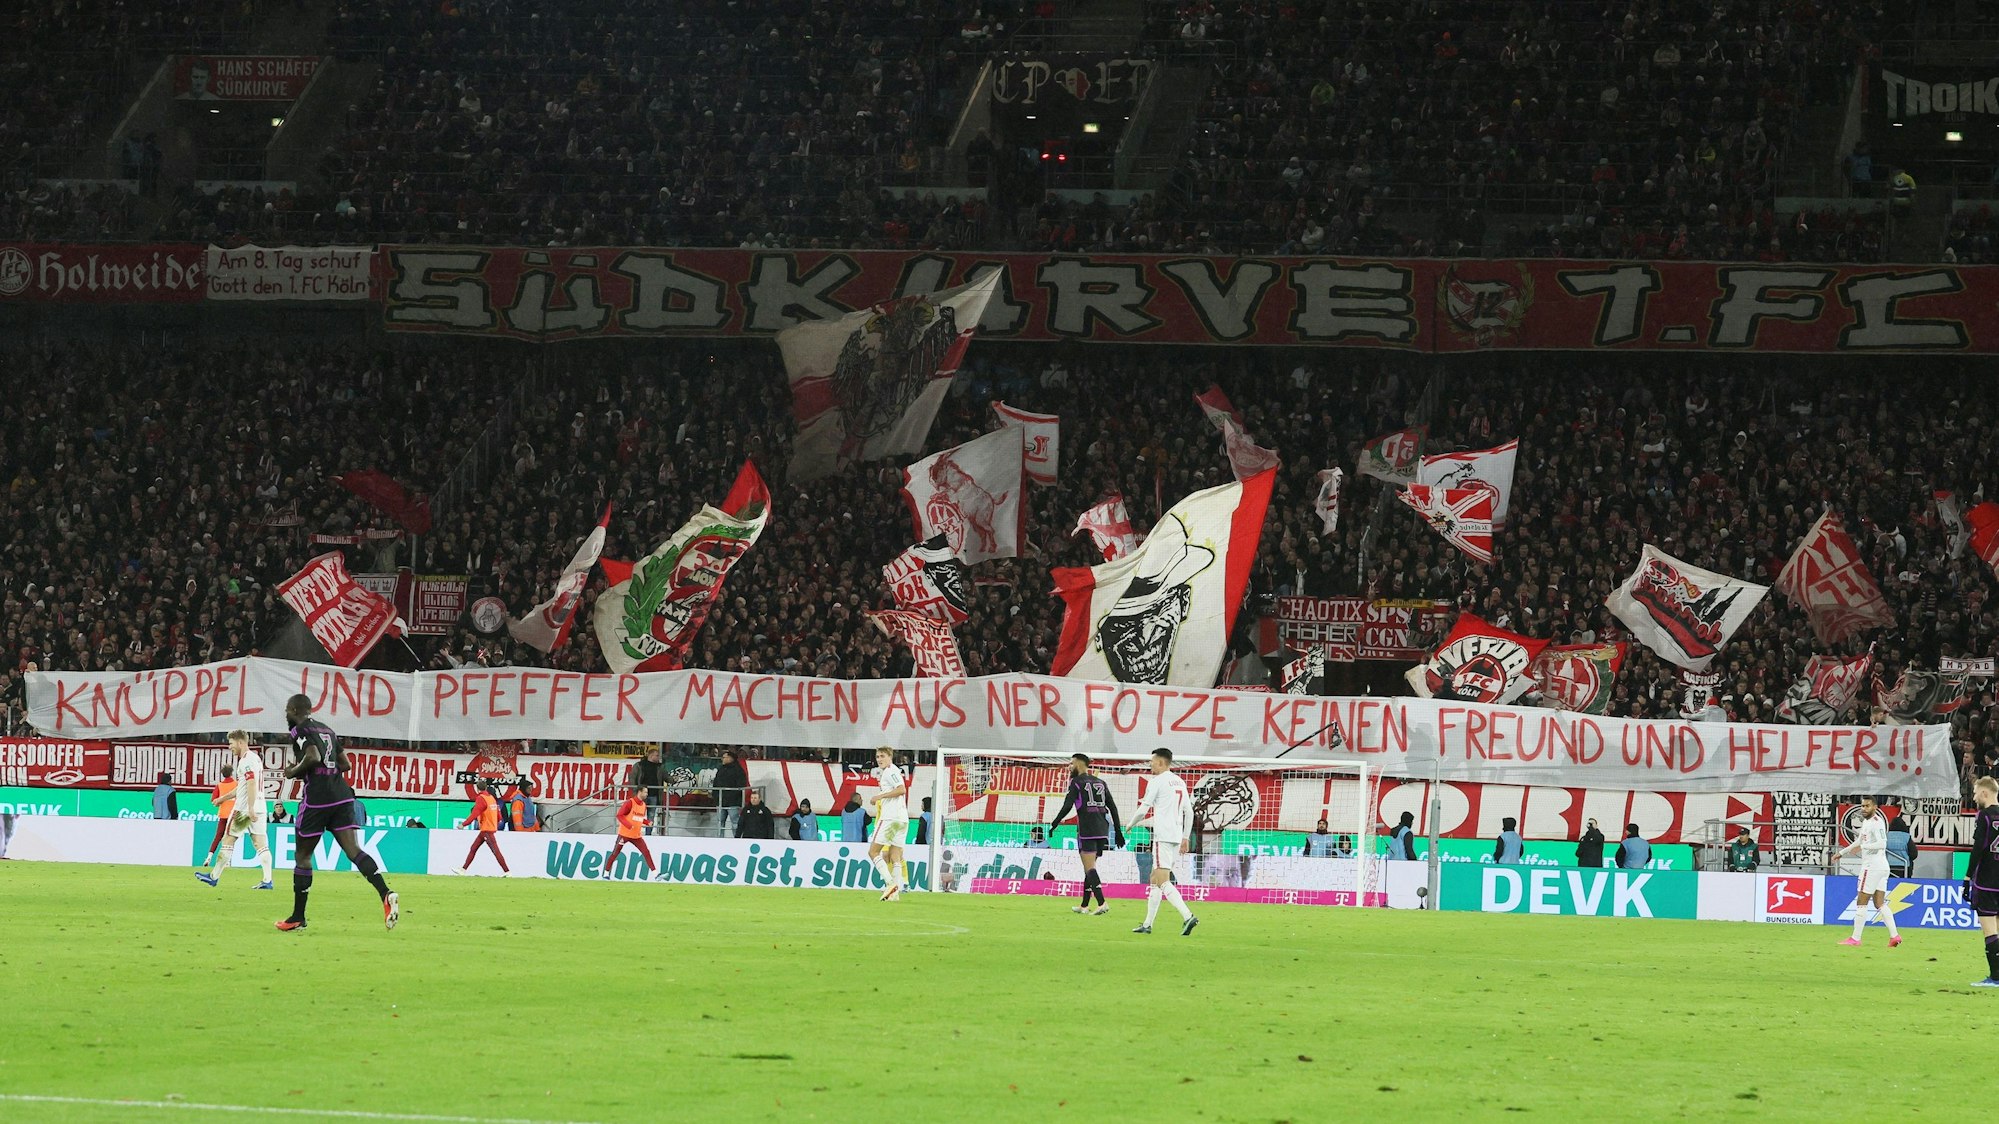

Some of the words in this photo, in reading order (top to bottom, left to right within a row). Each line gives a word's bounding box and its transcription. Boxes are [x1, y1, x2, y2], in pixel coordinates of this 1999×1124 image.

[217, 60, 253, 76] HANS
[217, 80, 288, 97] SÜDKURVE
[1882, 69, 1999, 119] TROIK
[38, 252, 201, 292] Holweide
[218, 252, 247, 269] Am
[254, 251, 272, 269] 8.
[274, 250, 303, 272] Tag
[310, 251, 362, 269] schuf
[212, 275, 247, 295] Gott
[253, 275, 283, 294] den
[328, 275, 366, 293] Köln
[1280, 600, 1364, 621] CHAOTIX
[1366, 602, 1412, 623] SPS
[1365, 627, 1408, 648] CGN
[55, 665, 263, 729] KNÜPPEL
[300, 667, 397, 718] UND
[434, 673, 643, 724] PFEFFER
[679, 673, 859, 723] MACHEN
[881, 680, 966, 731] AUS
[987, 680, 1066, 727] NER
[1084, 685, 1238, 740] FOTZE
[1262, 696, 1407, 753] KEINEN
[1439, 707, 1605, 764] FREUND
[1622, 723, 1705, 773] UND
[1728, 728, 1924, 776] HELFER!!!
[114, 746, 187, 784] SEMPER
[343, 752, 455, 796] OMSTADT
[530, 763, 635, 800] SYNDIKA
[989, 765, 1069, 794] STADIONVE
[1774, 791, 1833, 804] VIRAGE
[1774, 805, 1831, 818] AUTEUIL
[661, 851, 739, 884] was
[746, 843, 804, 888] ist,
[1481, 867, 1654, 918] DEVK
[1922, 885, 1972, 905] DIN
[1766, 916, 1813, 924] BUNDESLIGA
